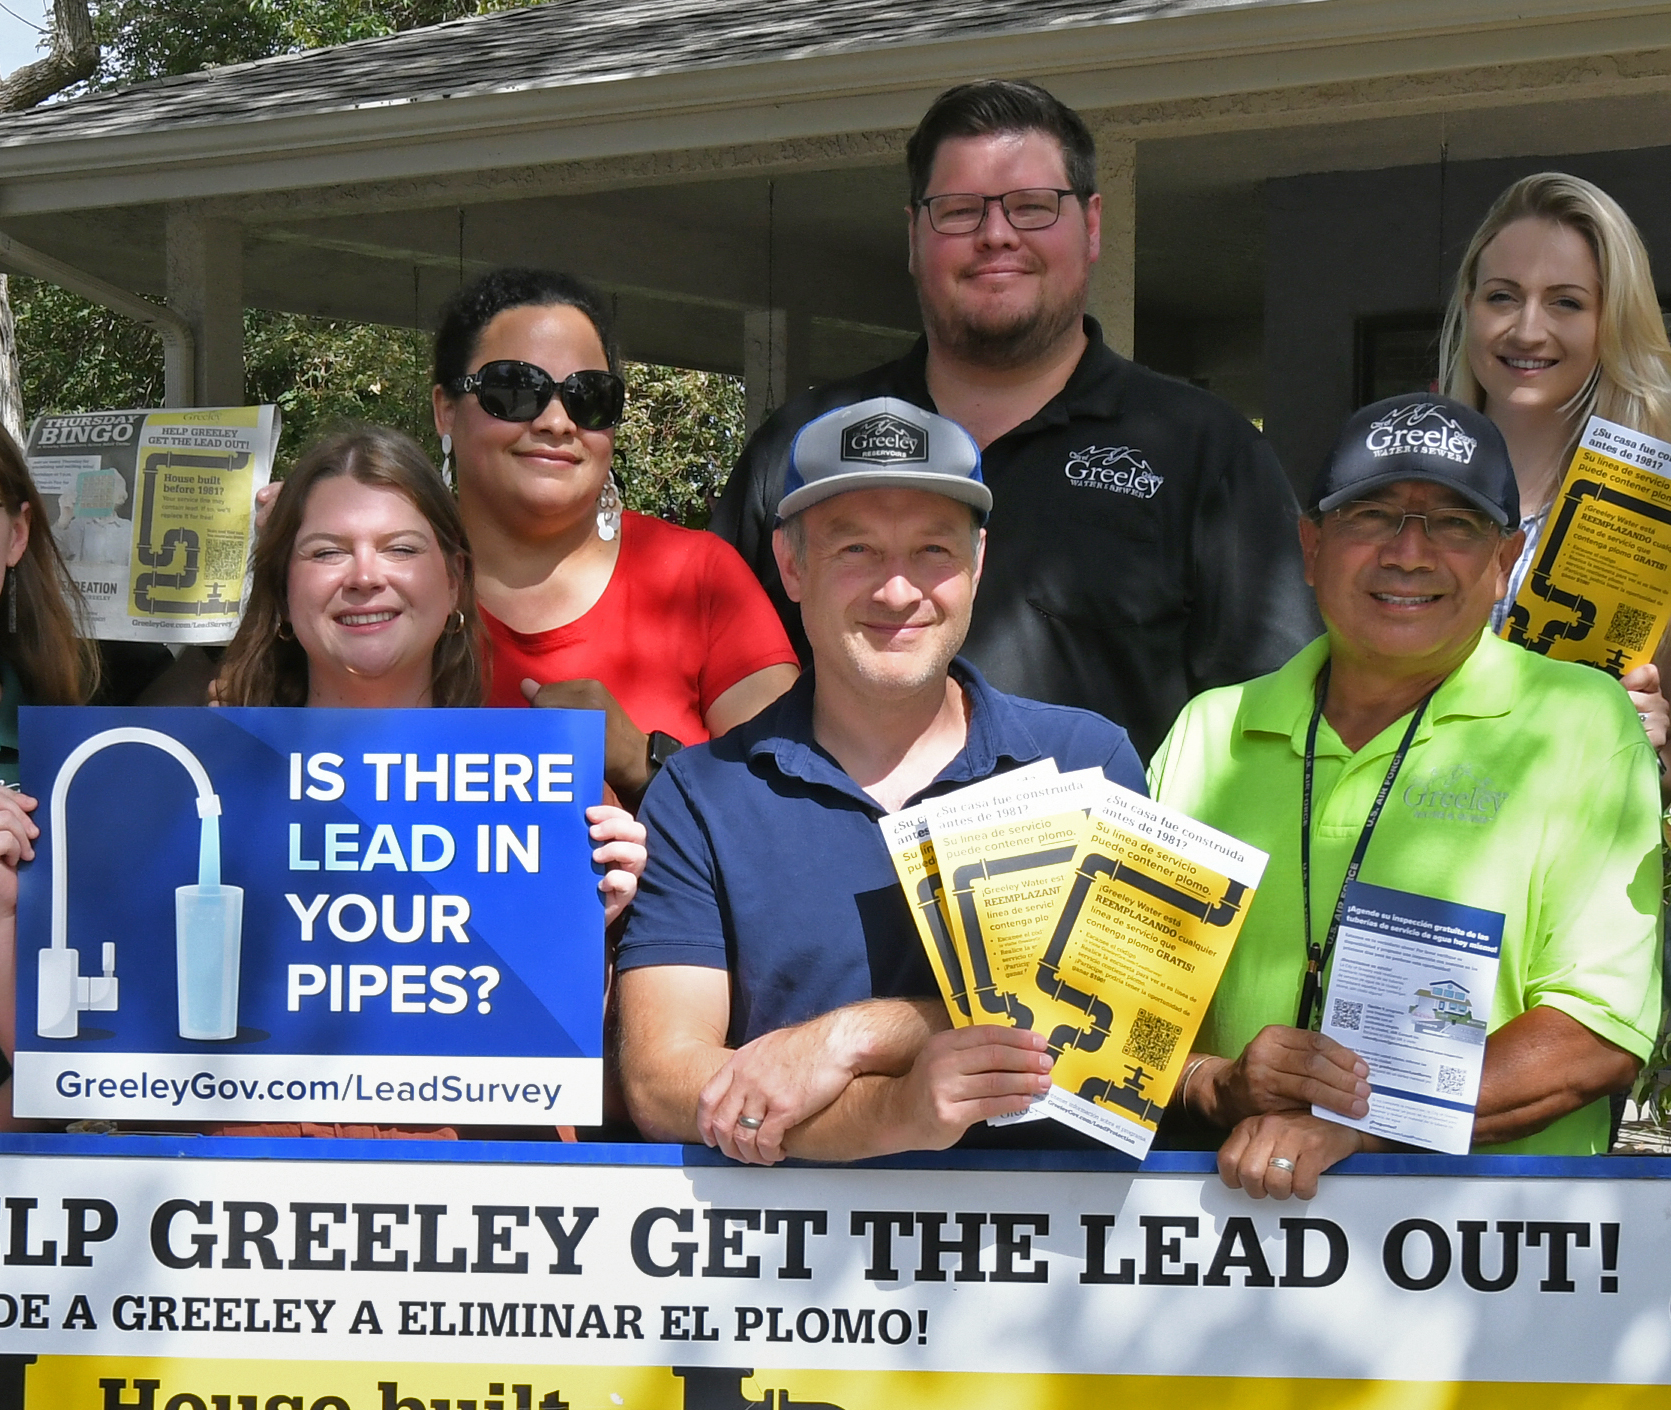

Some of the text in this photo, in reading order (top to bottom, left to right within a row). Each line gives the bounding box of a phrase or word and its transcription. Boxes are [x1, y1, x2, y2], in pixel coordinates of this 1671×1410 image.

[38, 424, 133, 445] BINGO
[45, 415, 139, 427] THURSDAY
[161, 427, 238, 438] HELP GREELEY
[148, 436, 249, 449] GET THE LEAD OUT!
[851, 434, 918, 454] Greeley
[862, 450, 907, 458] RESERVOIRS
[1366, 426, 1477, 464] Greeley
[1373, 446, 1412, 458] WATER
[1420, 446, 1463, 463] SEWER
[1592, 427, 1611, 439] ¿Su
[1613, 435, 1636, 448] casa
[1638, 442, 1655, 455] fue
[163, 473, 220, 485] House built
[163, 483, 224, 495] before 1981?
[1065, 460, 1163, 498] Greeley
[289, 752, 572, 801] IS THERE
[289, 823, 538, 872] LEAD IN
[285, 893, 470, 942] YOUR
[287, 964, 499, 1013] PIPES?
[56, 1071, 561, 1109] GreeleyGov.com/LeadSurvey
[150, 1199, 598, 1274] GREELEY
[630, 1207, 827, 1279] GET
[850, 1210, 1049, 1289] THE
[1079, 1214, 1348, 1287] LEAD
[1382, 1218, 1620, 1292] OUT!
[62, 1295, 96, 1329] A
[112, 1294, 335, 1332] GREELEY
[348, 1300, 382, 1333] A
[398, 1301, 643, 1338] ELIMINAR
[660, 1305, 718, 1340] EL
[734, 1307, 927, 1344] PLOMO!
